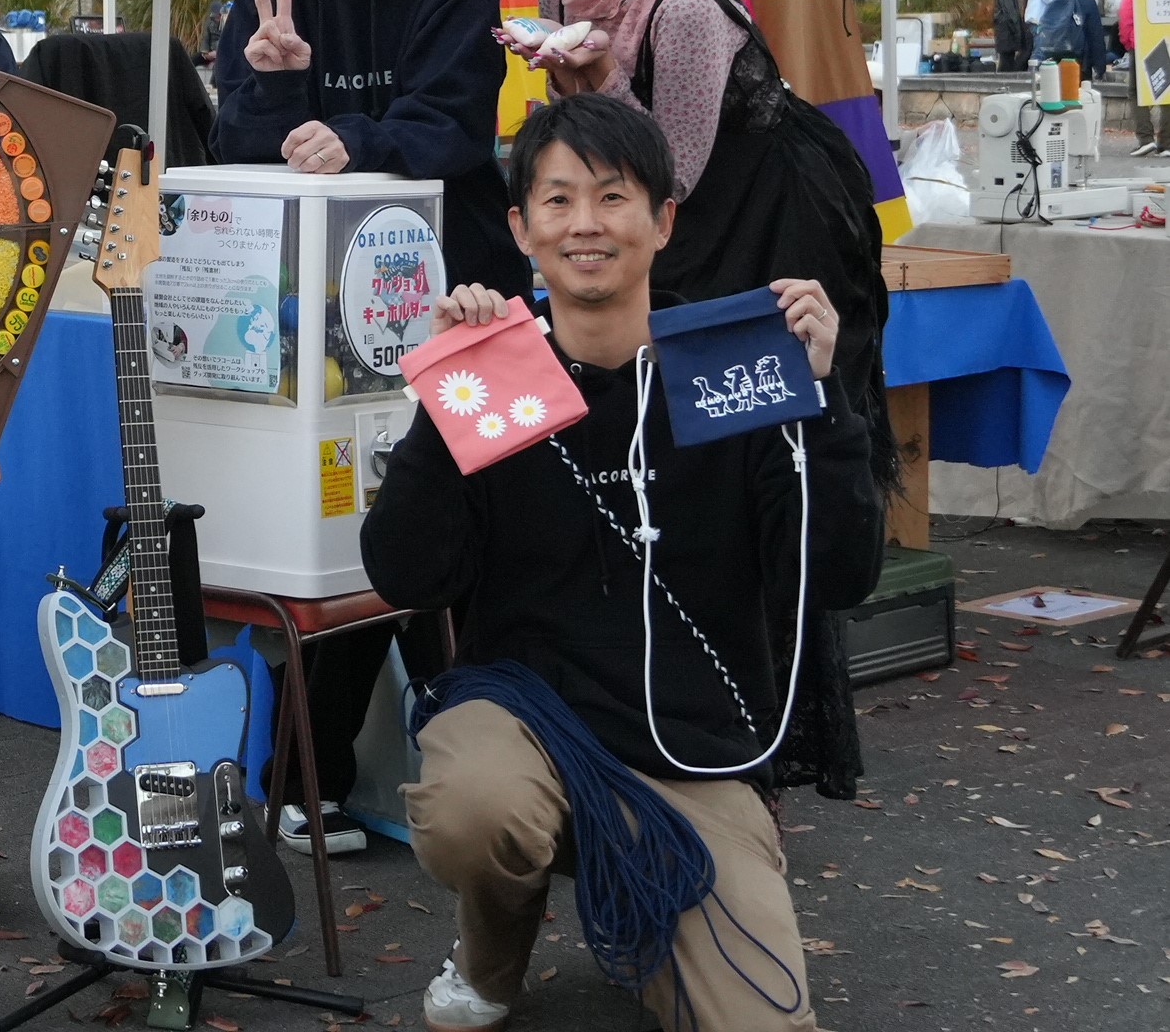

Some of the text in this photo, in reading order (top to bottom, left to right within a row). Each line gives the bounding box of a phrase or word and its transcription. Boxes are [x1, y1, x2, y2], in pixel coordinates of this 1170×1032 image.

[214, 226, 280, 239] 忘れられない時間を
[358, 228, 433, 248] ORIGINAL
[374, 251, 419, 269] GOODS
[363, 300, 430, 325] キーホルダー
[363, 335, 375, 345] 1回
[576, 469, 656, 485] CORE
